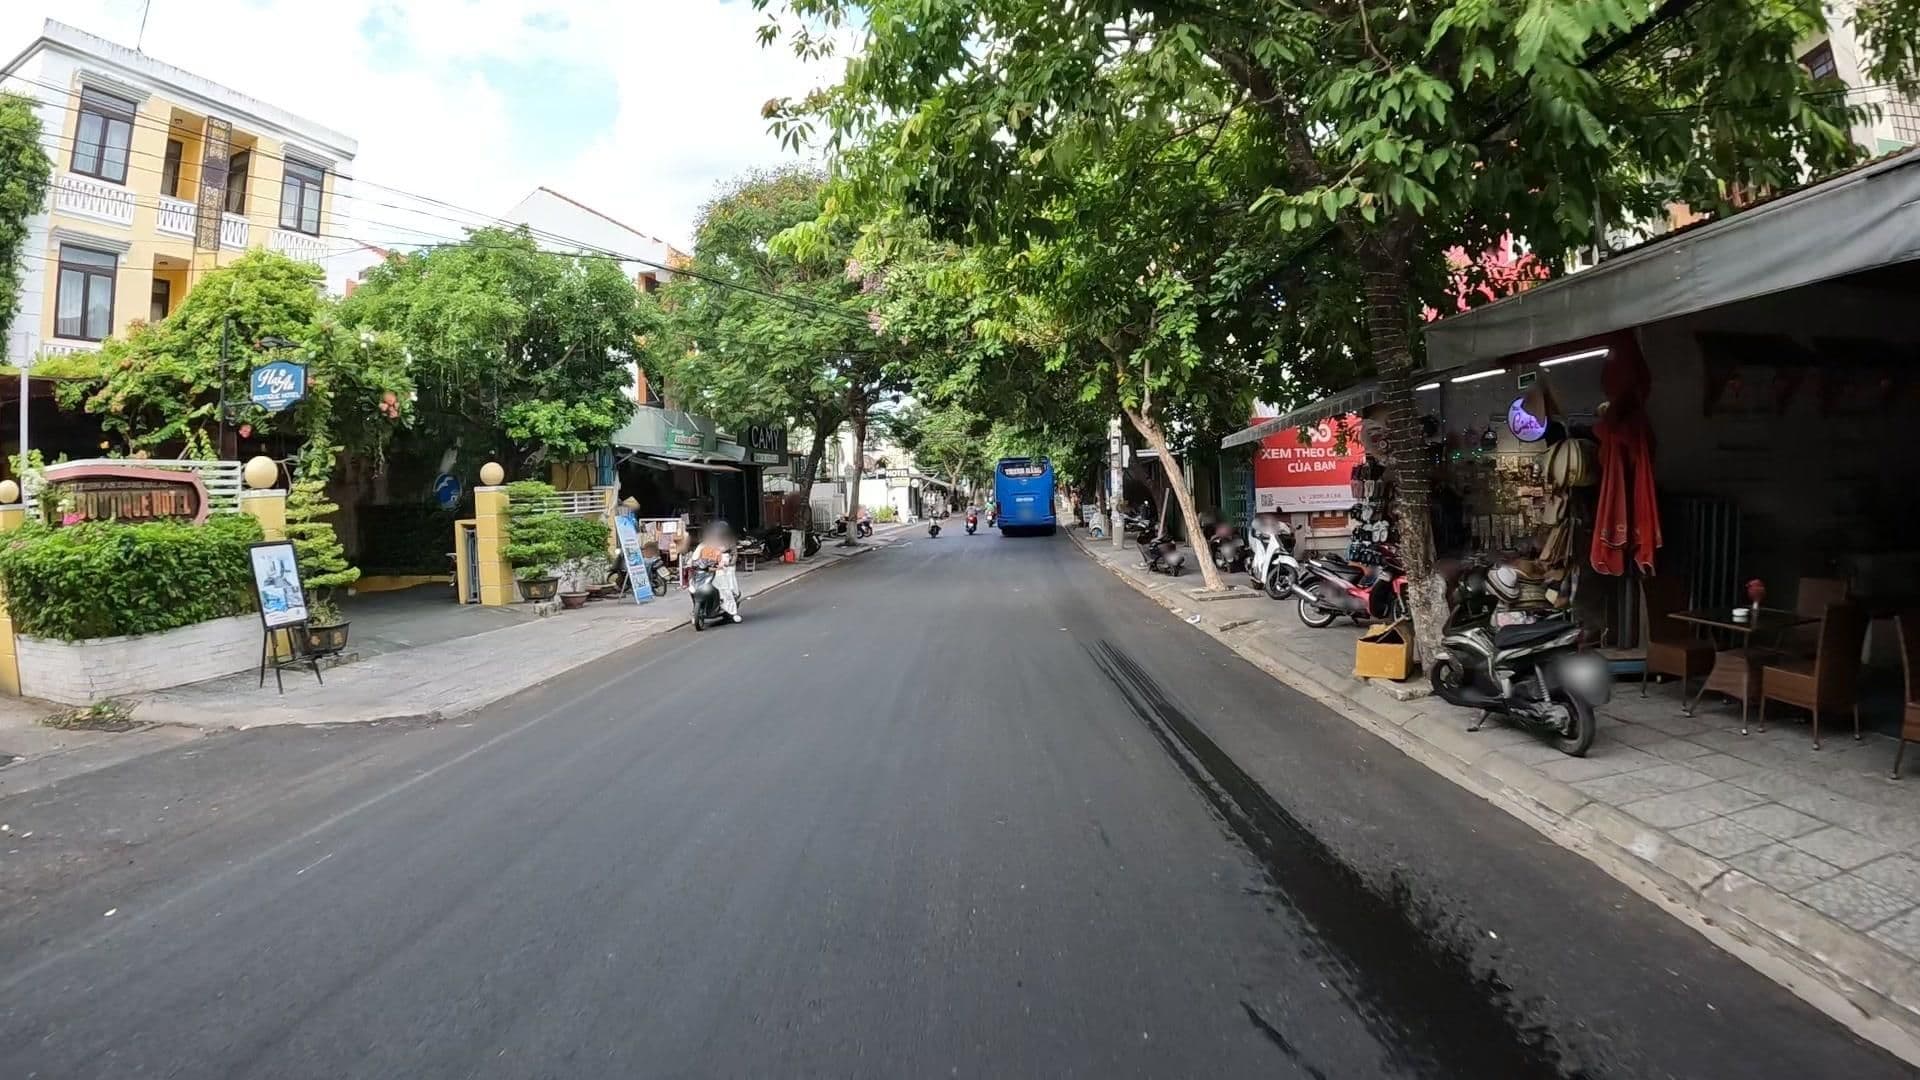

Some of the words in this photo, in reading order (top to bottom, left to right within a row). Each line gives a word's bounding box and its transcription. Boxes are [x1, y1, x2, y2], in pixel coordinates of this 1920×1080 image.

[751, 425, 780, 451] CAMY
[1261, 448, 1292, 459] XEM
[1294, 447, 1325, 458] THEO
[1287, 460, 1312, 473] CỦA
[1313, 460, 1336, 472] BẠN
